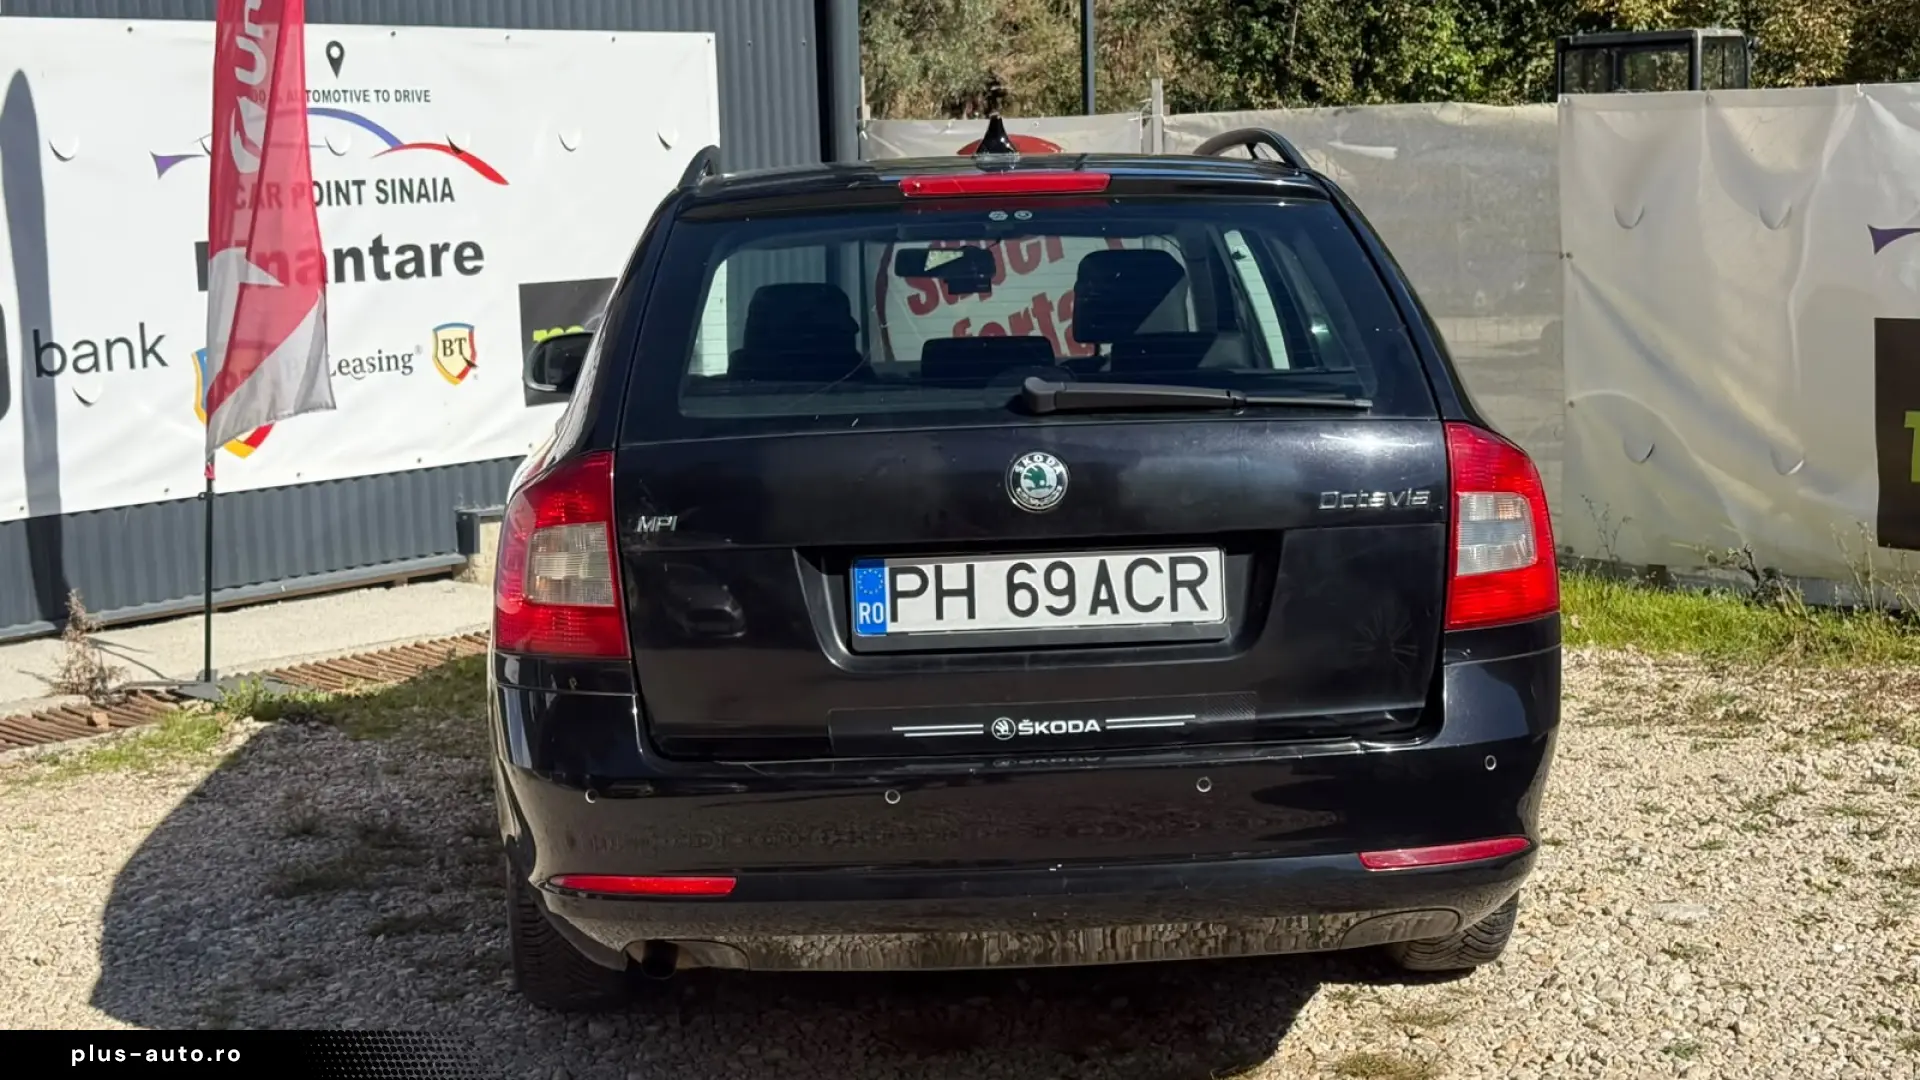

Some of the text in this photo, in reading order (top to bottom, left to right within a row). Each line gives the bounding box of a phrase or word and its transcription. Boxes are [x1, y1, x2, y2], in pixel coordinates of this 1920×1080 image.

[374, 91, 391, 102] TO
[394, 90, 431, 102] DRIVE
[375, 177, 455, 205] SINAIA
[33, 322, 169, 378] bank
[441, 337, 467, 358] BT
[1318, 488, 1431, 510] Octavia
[636, 515, 678, 533] MPI
[889, 564, 976, 623] PH
[859, 602, 884, 624] RO
[1018, 719, 1101, 735] ŠKODA
